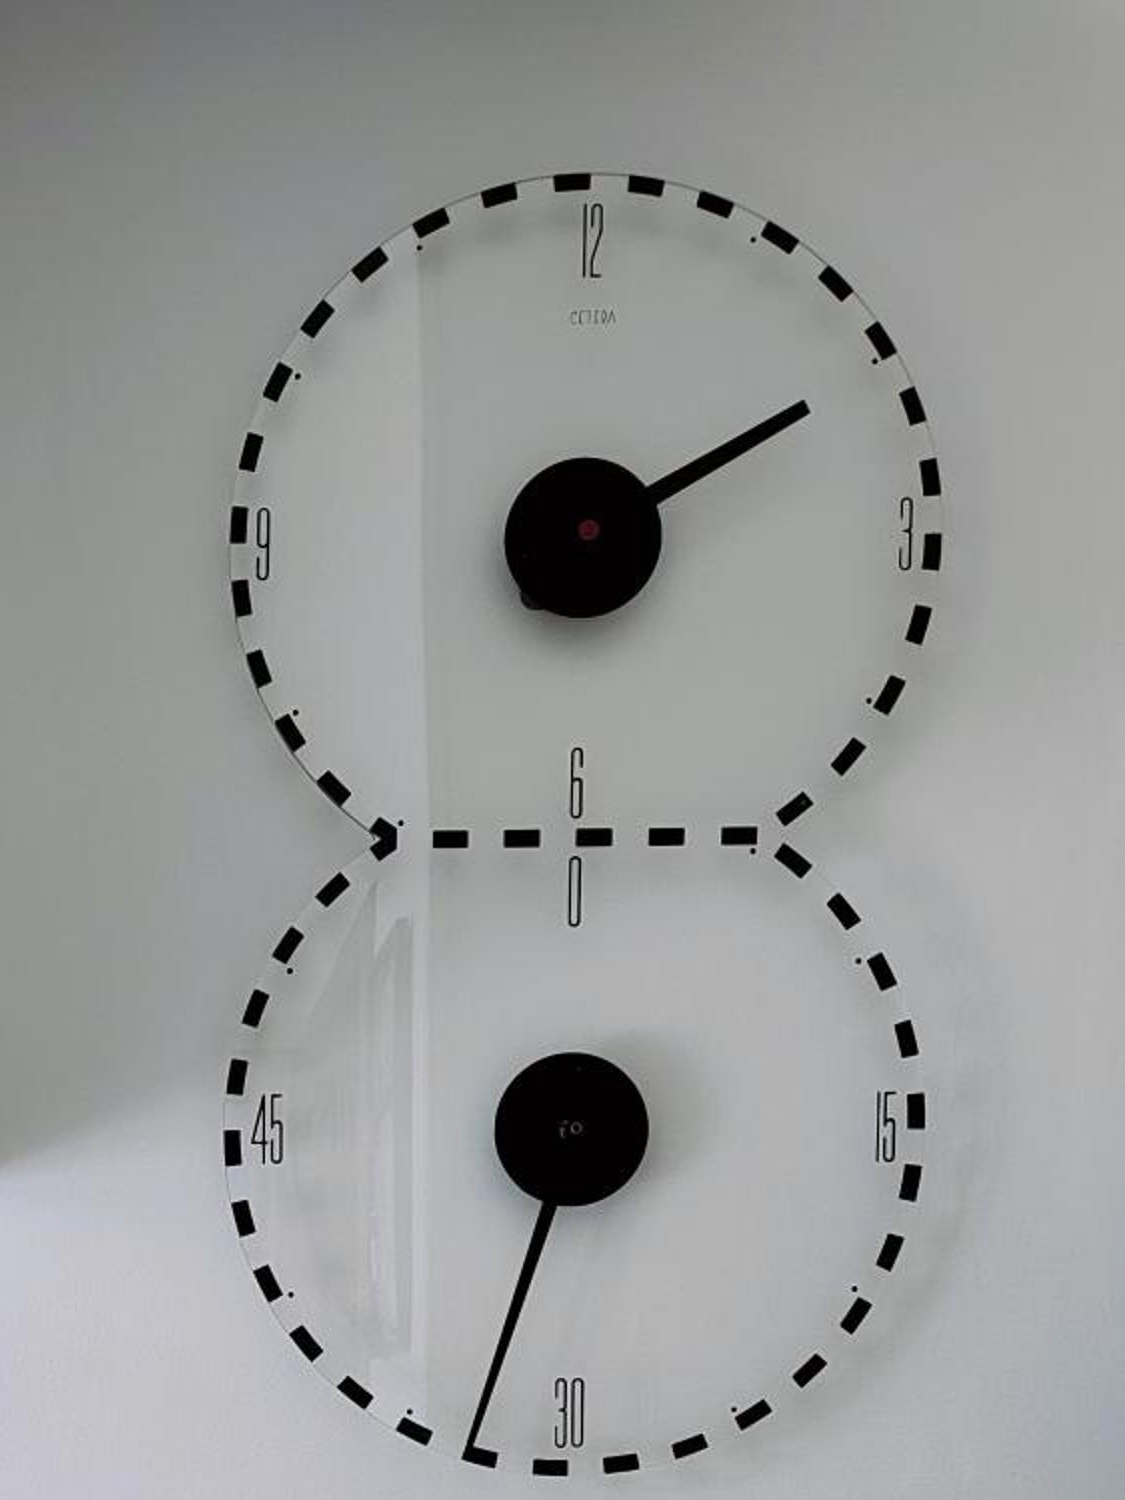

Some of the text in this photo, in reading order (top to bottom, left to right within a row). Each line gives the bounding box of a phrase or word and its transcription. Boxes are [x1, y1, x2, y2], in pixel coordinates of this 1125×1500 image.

[581, 203, 605, 279] 12
[255, 506, 271, 582] 9
[898, 496, 914, 572] 3
[568, 747, 585, 821] 6
[567, 854, 583, 928] 0
[249, 1093, 285, 1166] 45
[874, 1090, 898, 1164] 15
[553, 1376, 586, 1450] 30
